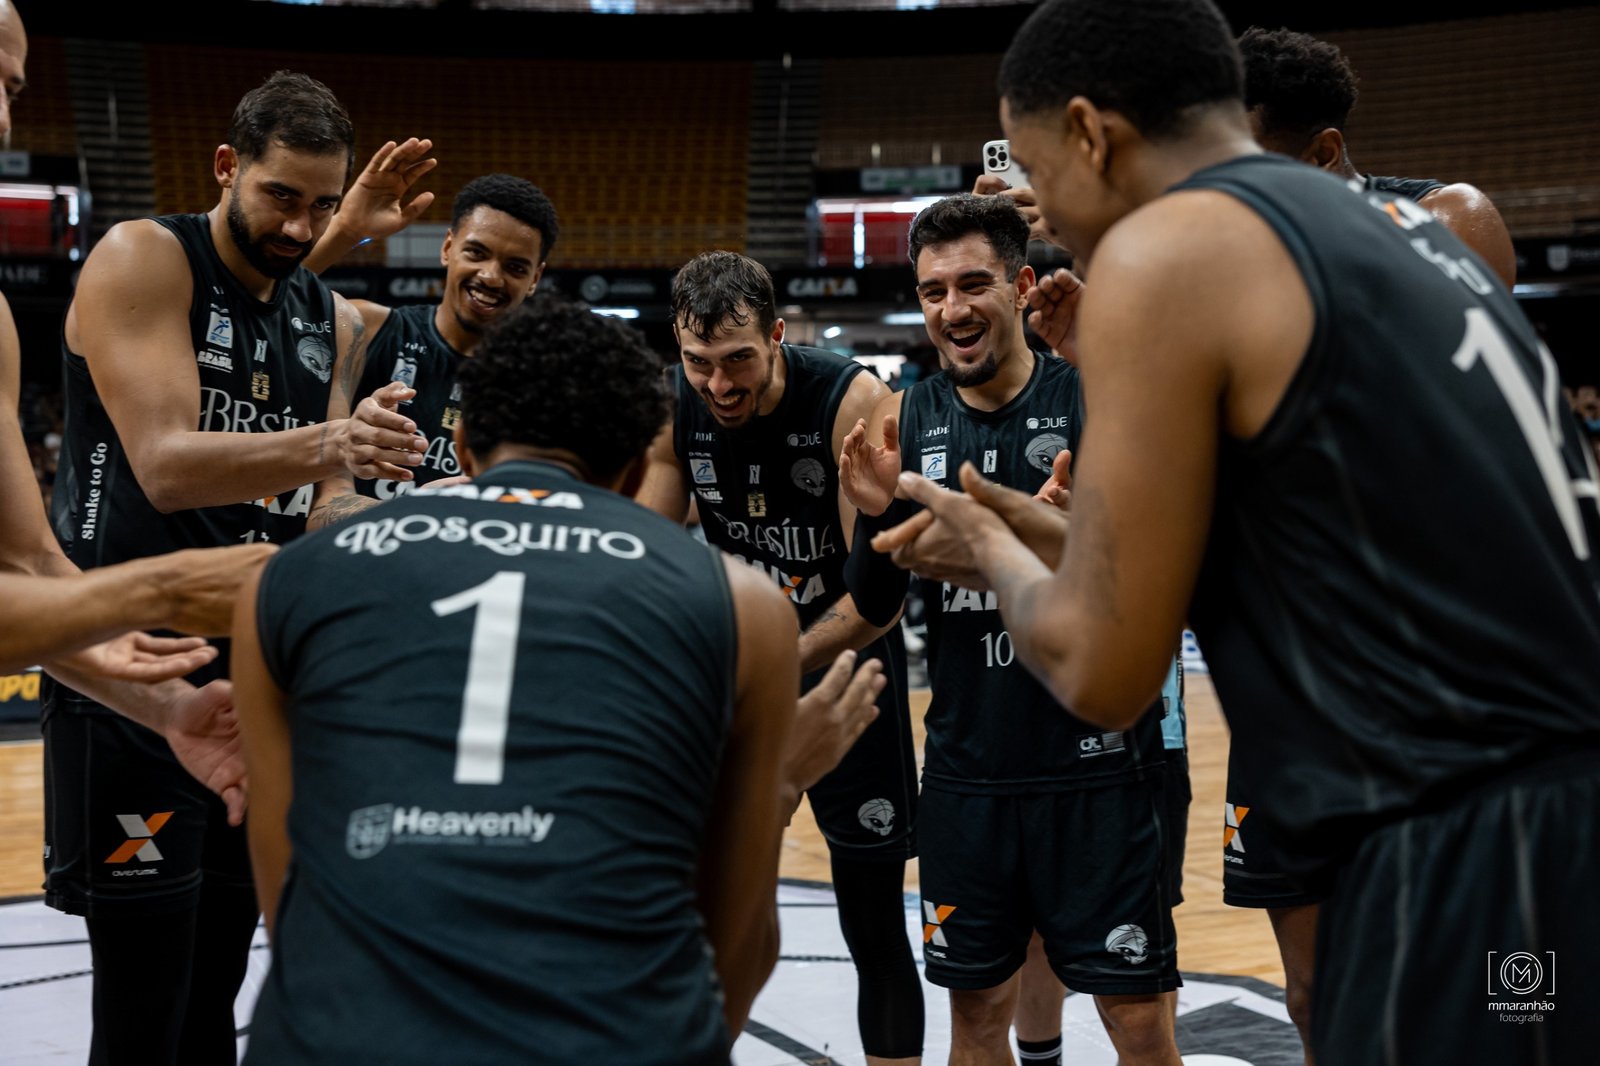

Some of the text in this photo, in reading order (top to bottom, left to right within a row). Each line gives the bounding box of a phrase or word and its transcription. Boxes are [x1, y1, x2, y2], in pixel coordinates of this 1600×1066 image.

[81, 442, 108, 540] Shake to Go
[334, 514, 647, 560] MOSQUITO
[980, 630, 1015, 667] 10
[431, 571, 526, 785] 1
[392, 805, 555, 843] Heavenly
